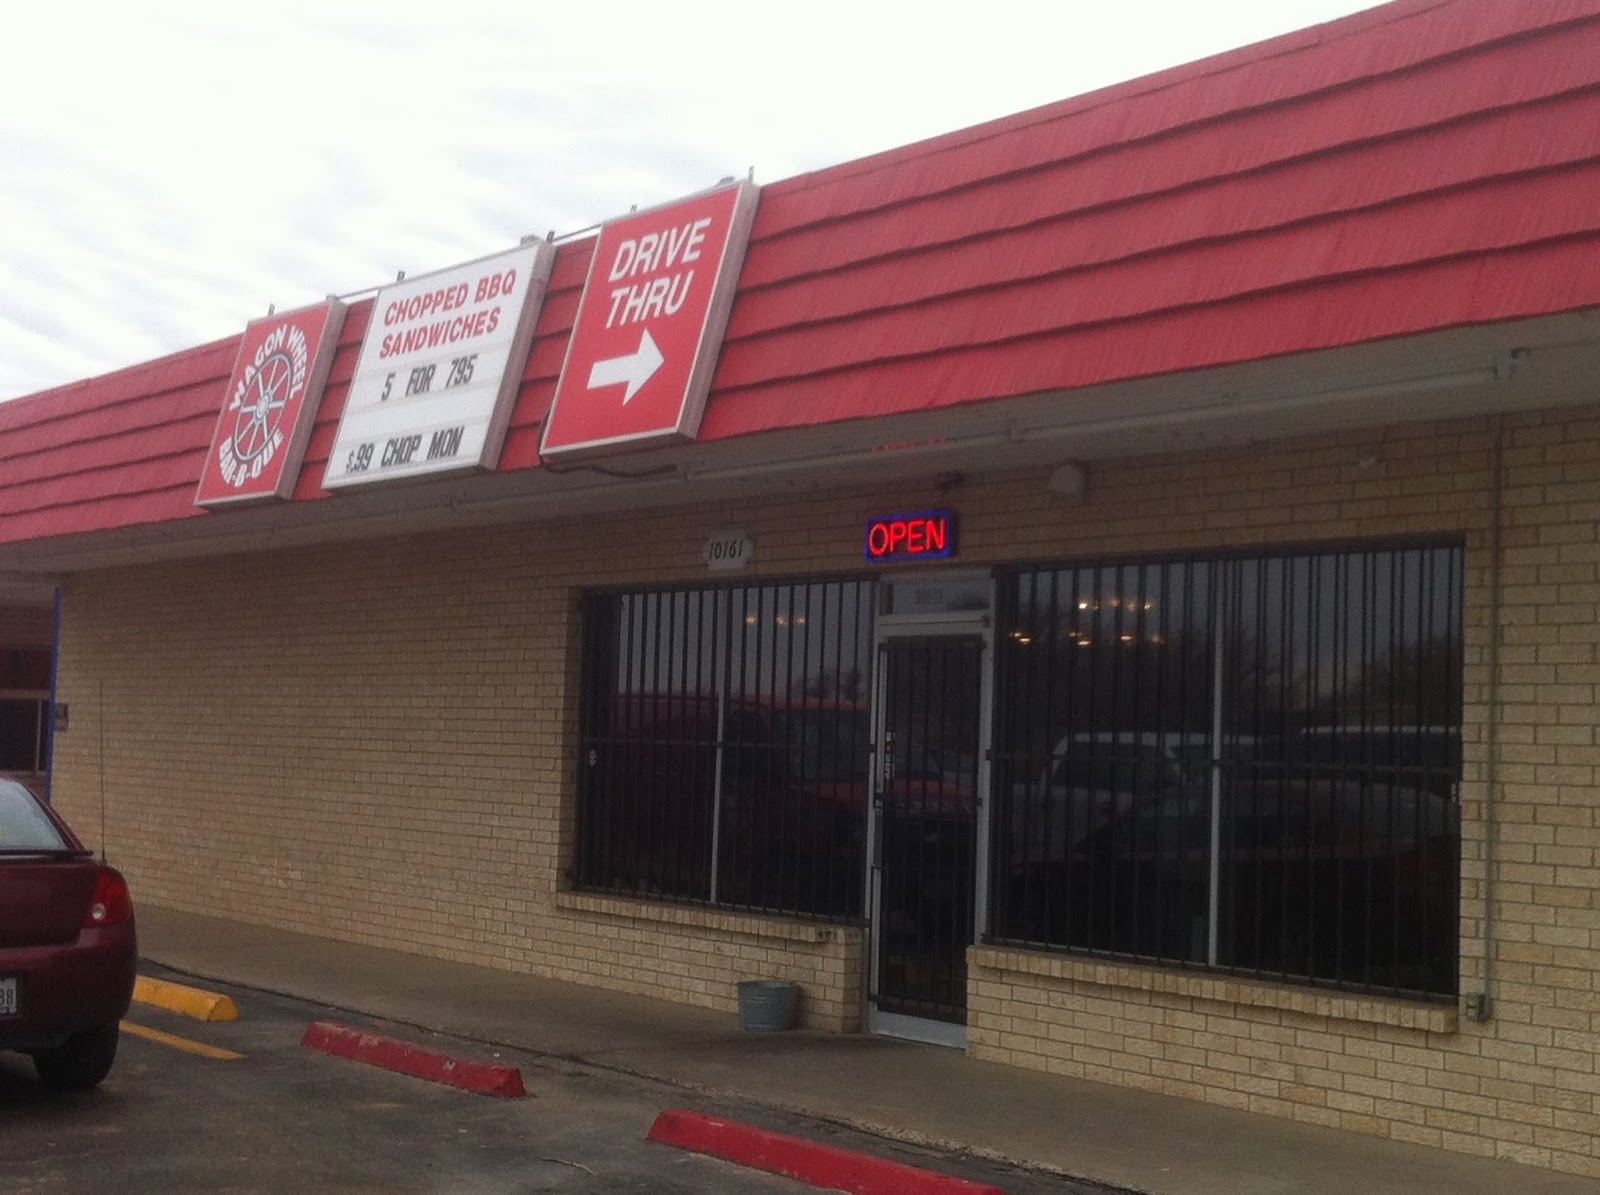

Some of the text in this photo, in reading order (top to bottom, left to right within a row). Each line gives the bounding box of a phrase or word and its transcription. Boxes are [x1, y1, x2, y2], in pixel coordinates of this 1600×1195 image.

[607, 217, 712, 282] DRIVE
[385, 269, 516, 326] CHOPPED BBQ
[606, 270, 694, 329] THRU
[379, 306, 501, 359] SANDWICHES
[229, 324, 308, 411] WAGON WHEEL
[381, 354, 478, 401] 5 FOR 795
[381, 434, 423, 467] CHOP
[427, 425, 465, 460] MON
[708, 539, 743, 560] 10161
[868, 518, 946, 555] OPEN
